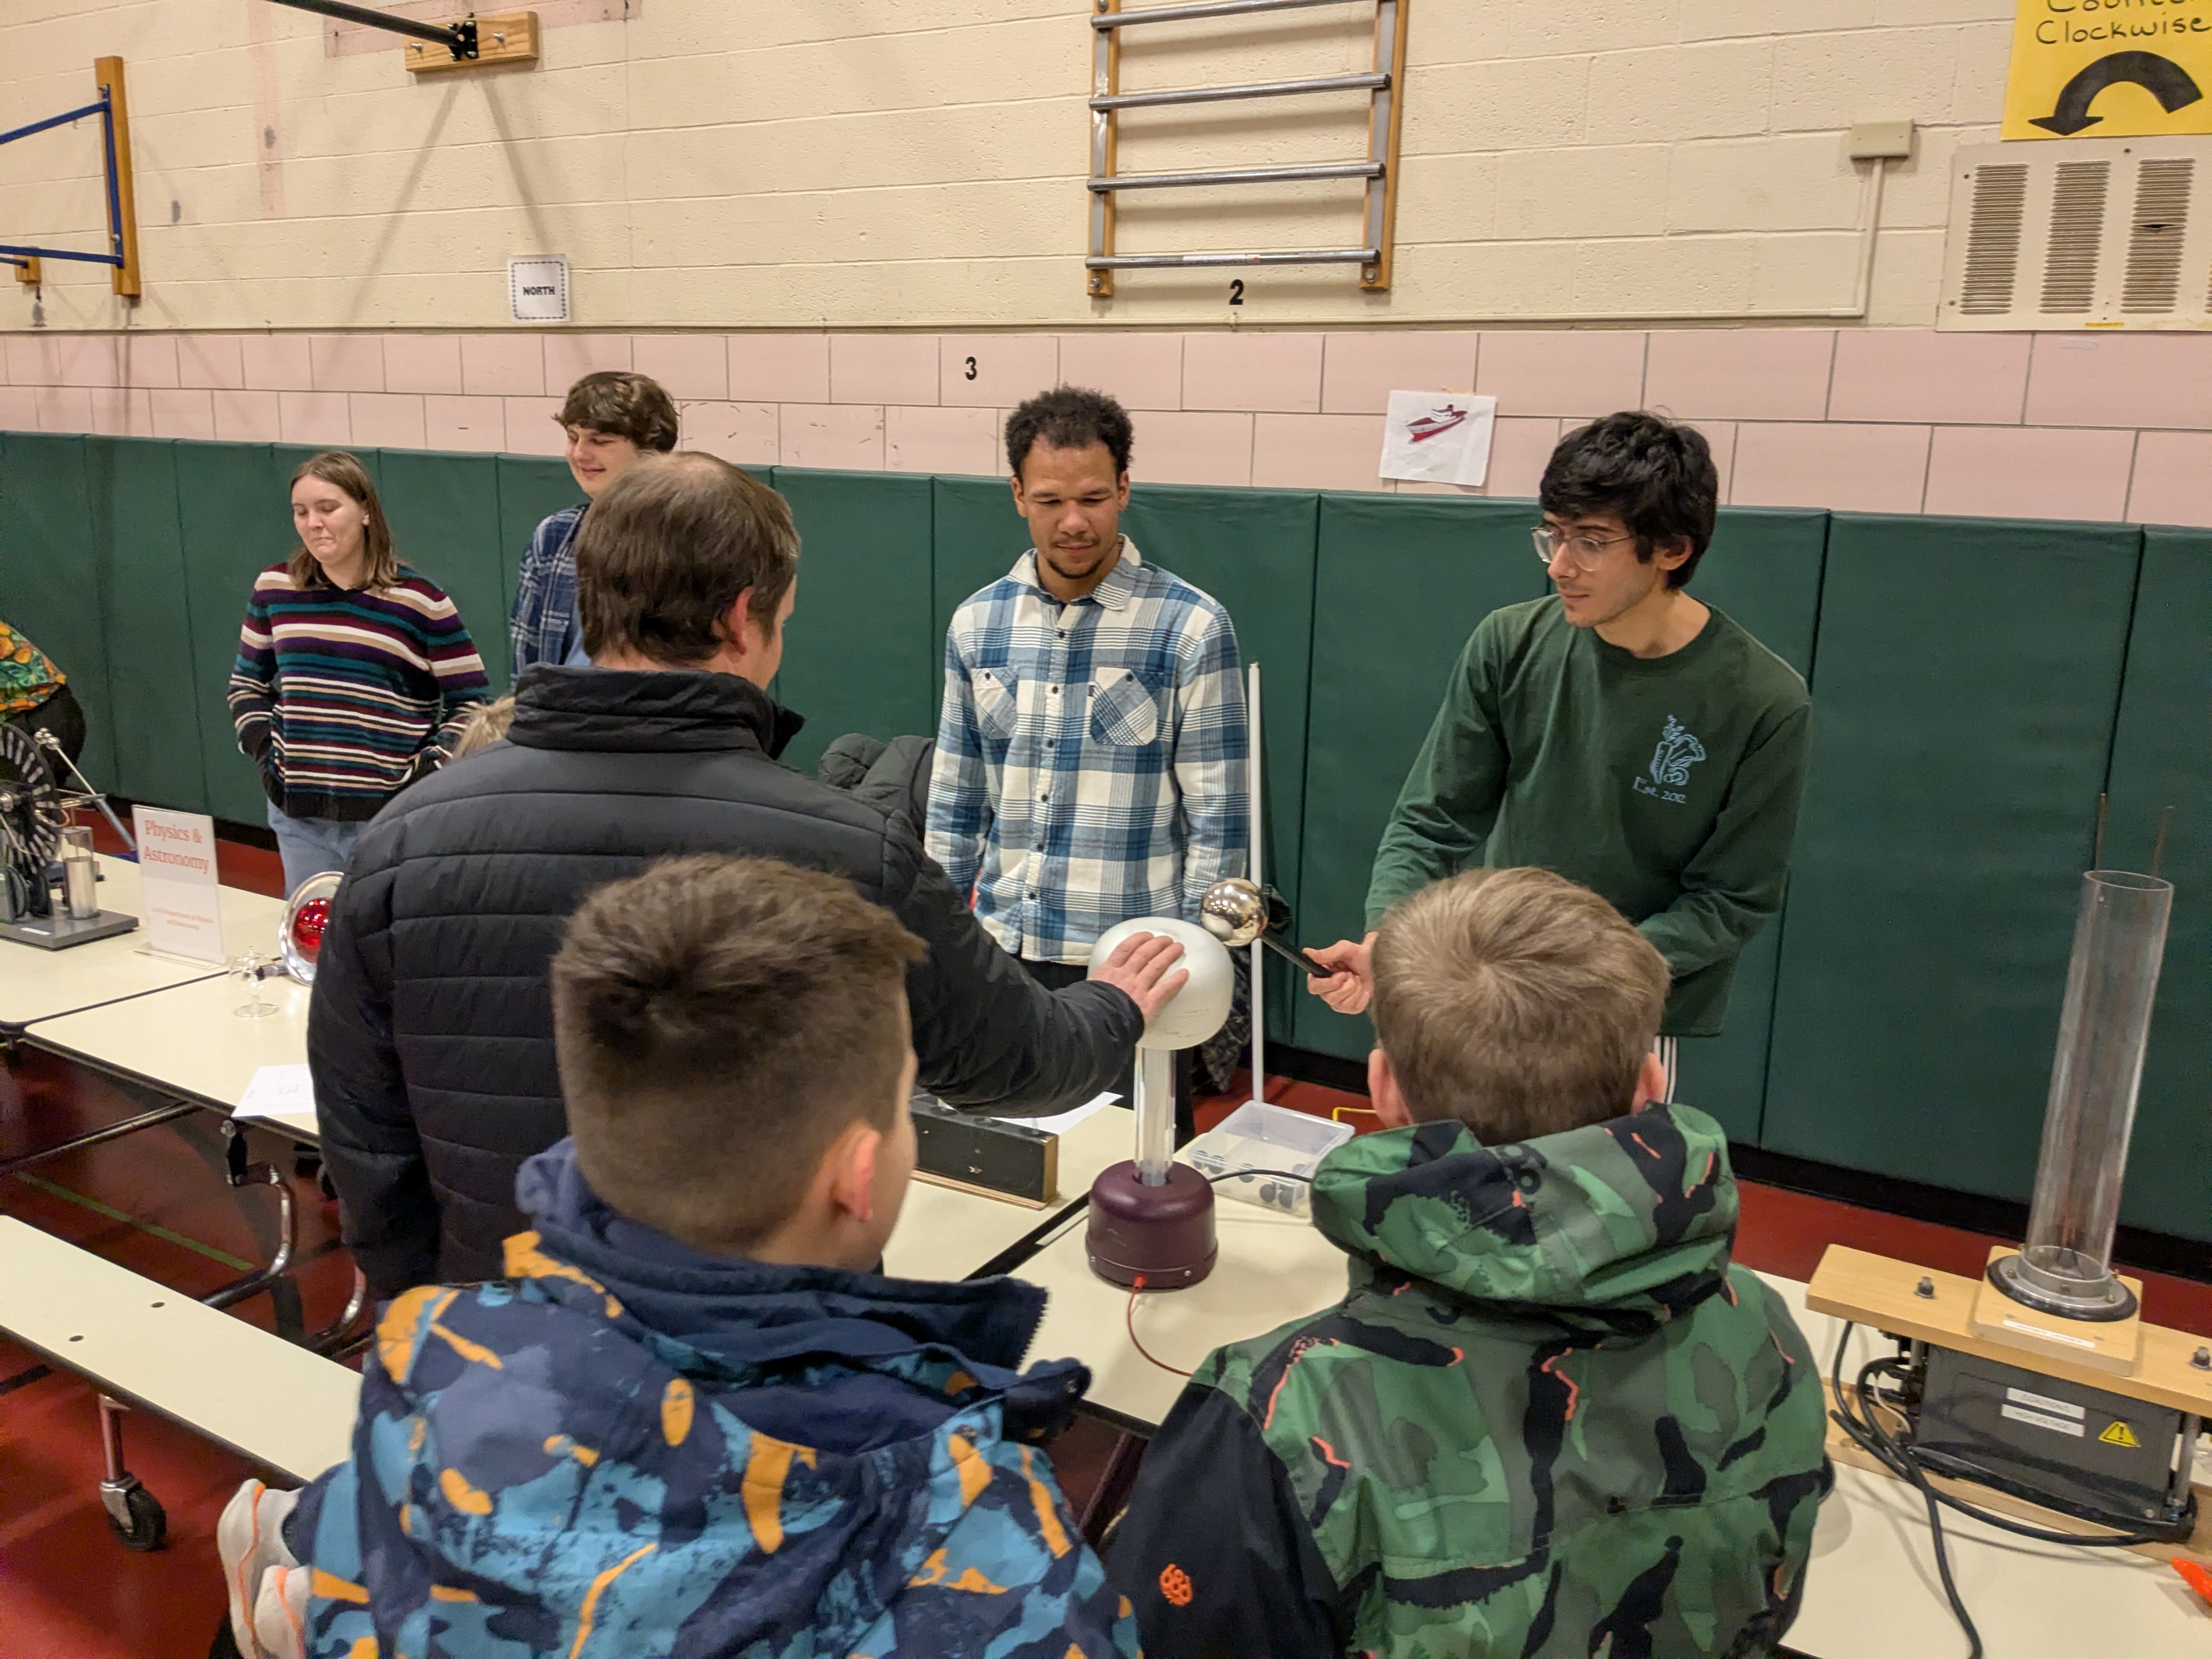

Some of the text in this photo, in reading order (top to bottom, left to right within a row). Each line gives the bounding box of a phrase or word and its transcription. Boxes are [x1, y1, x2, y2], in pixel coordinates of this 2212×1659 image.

[2036, 12, 2212, 44] Clockwise
[522, 286, 555, 295] NORTH
[1229, 279, 1244, 305] 2
[965, 357, 977, 380] 3
[144, 820, 202, 843] Physics &
[143, 845, 210, 874] Astronomy
